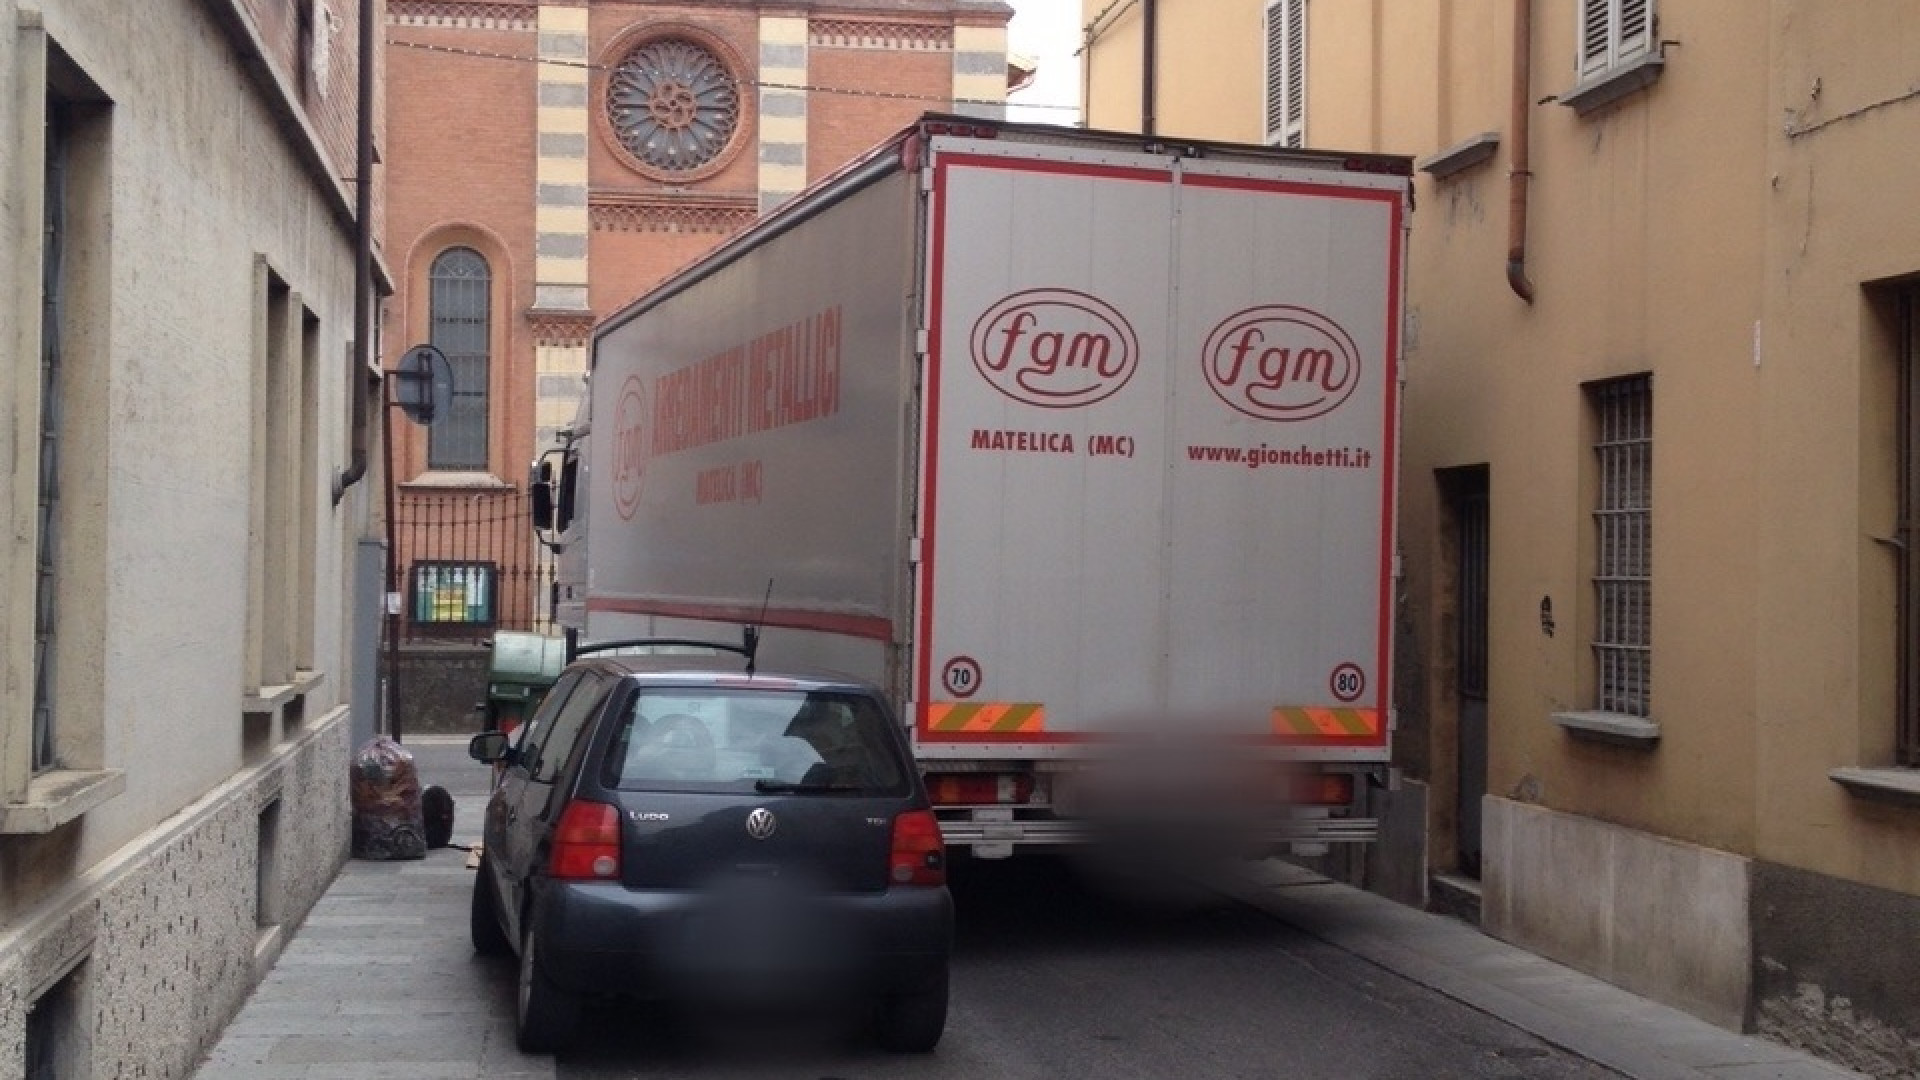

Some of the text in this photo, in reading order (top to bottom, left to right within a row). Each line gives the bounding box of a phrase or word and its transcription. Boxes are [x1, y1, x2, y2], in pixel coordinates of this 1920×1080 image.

[984, 311, 1127, 396] fgm
[747, 305, 841, 434] METALLICI
[1214, 328, 1350, 409] fgm
[970, 430, 1135, 458] MATELICA (MC)
[1188, 443, 1371, 468] www.gionchetti.it
[952, 668, 970, 685] 70
[1338, 674, 1358, 692] 80
